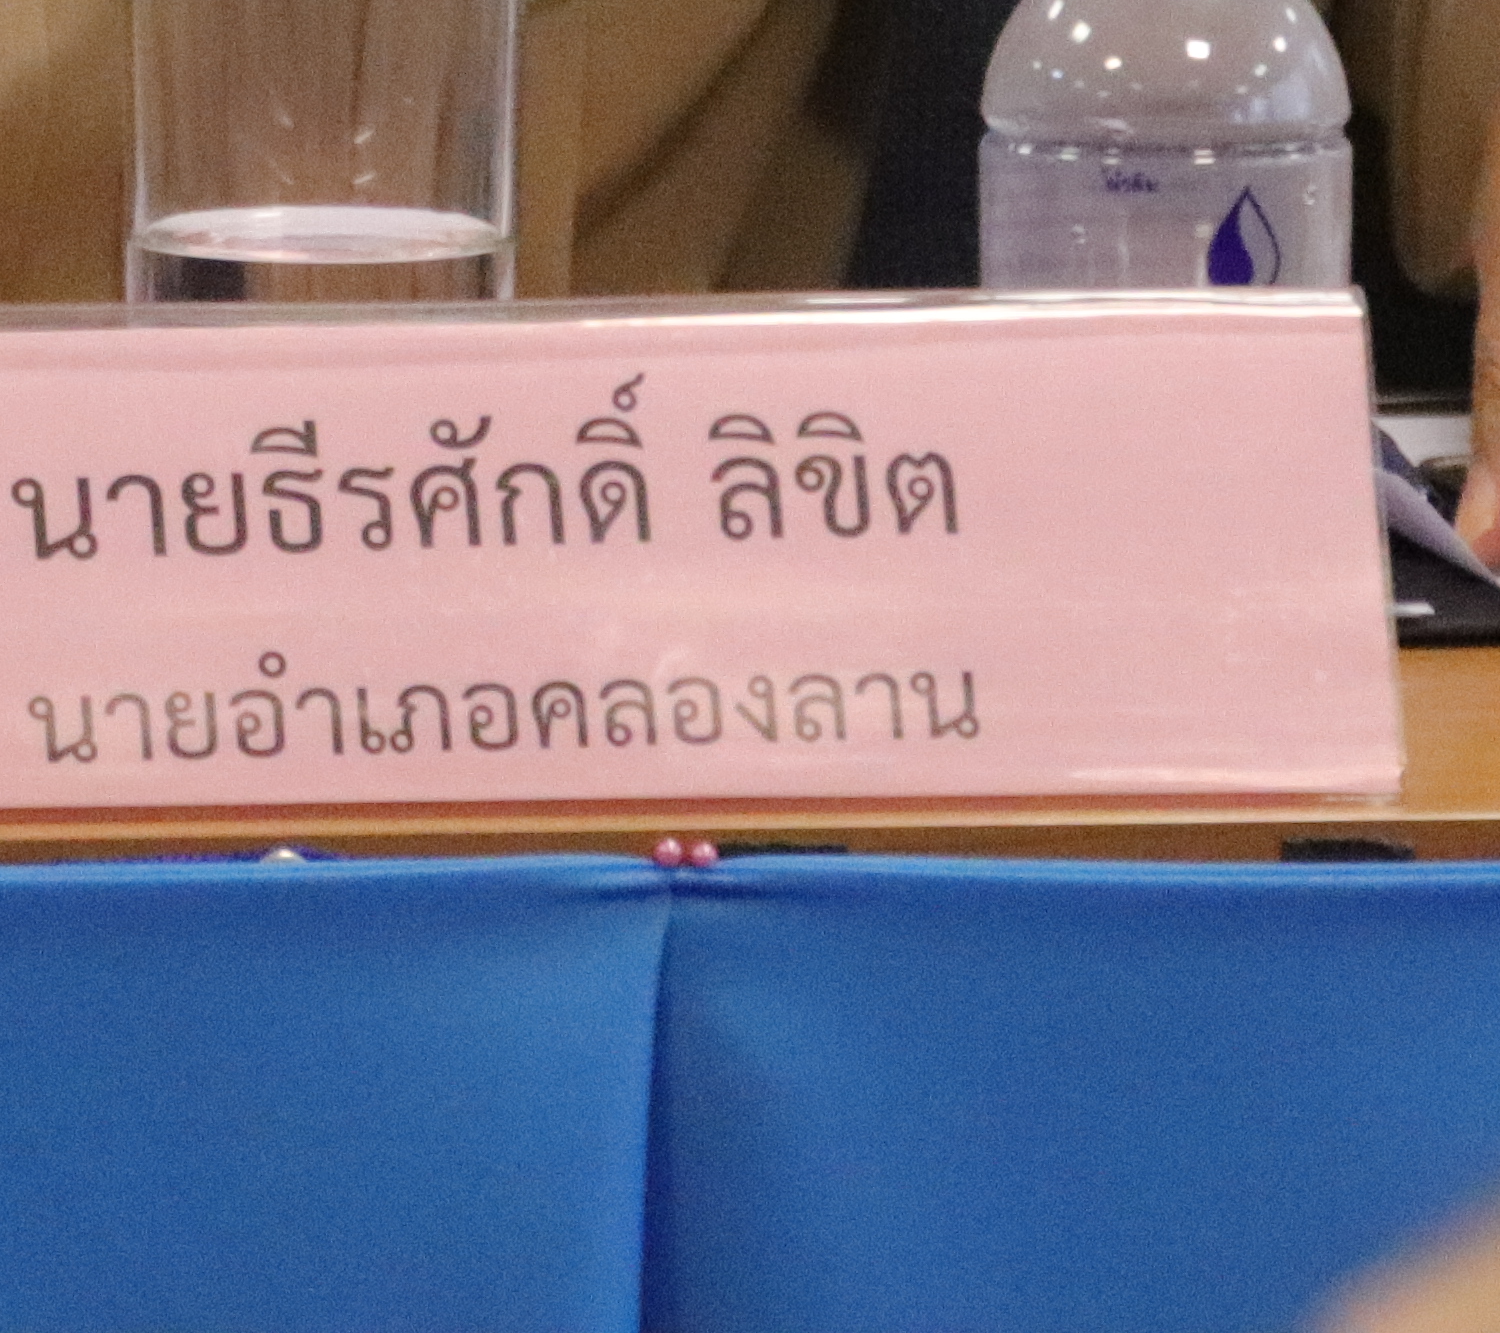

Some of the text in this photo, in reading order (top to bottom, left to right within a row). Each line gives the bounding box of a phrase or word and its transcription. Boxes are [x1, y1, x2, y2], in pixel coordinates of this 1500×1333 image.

[12, 372, 957, 559] นายธีรศักดิ์ ลิขิต
[25, 651, 984, 763] นายอำเภอคลองลาน
